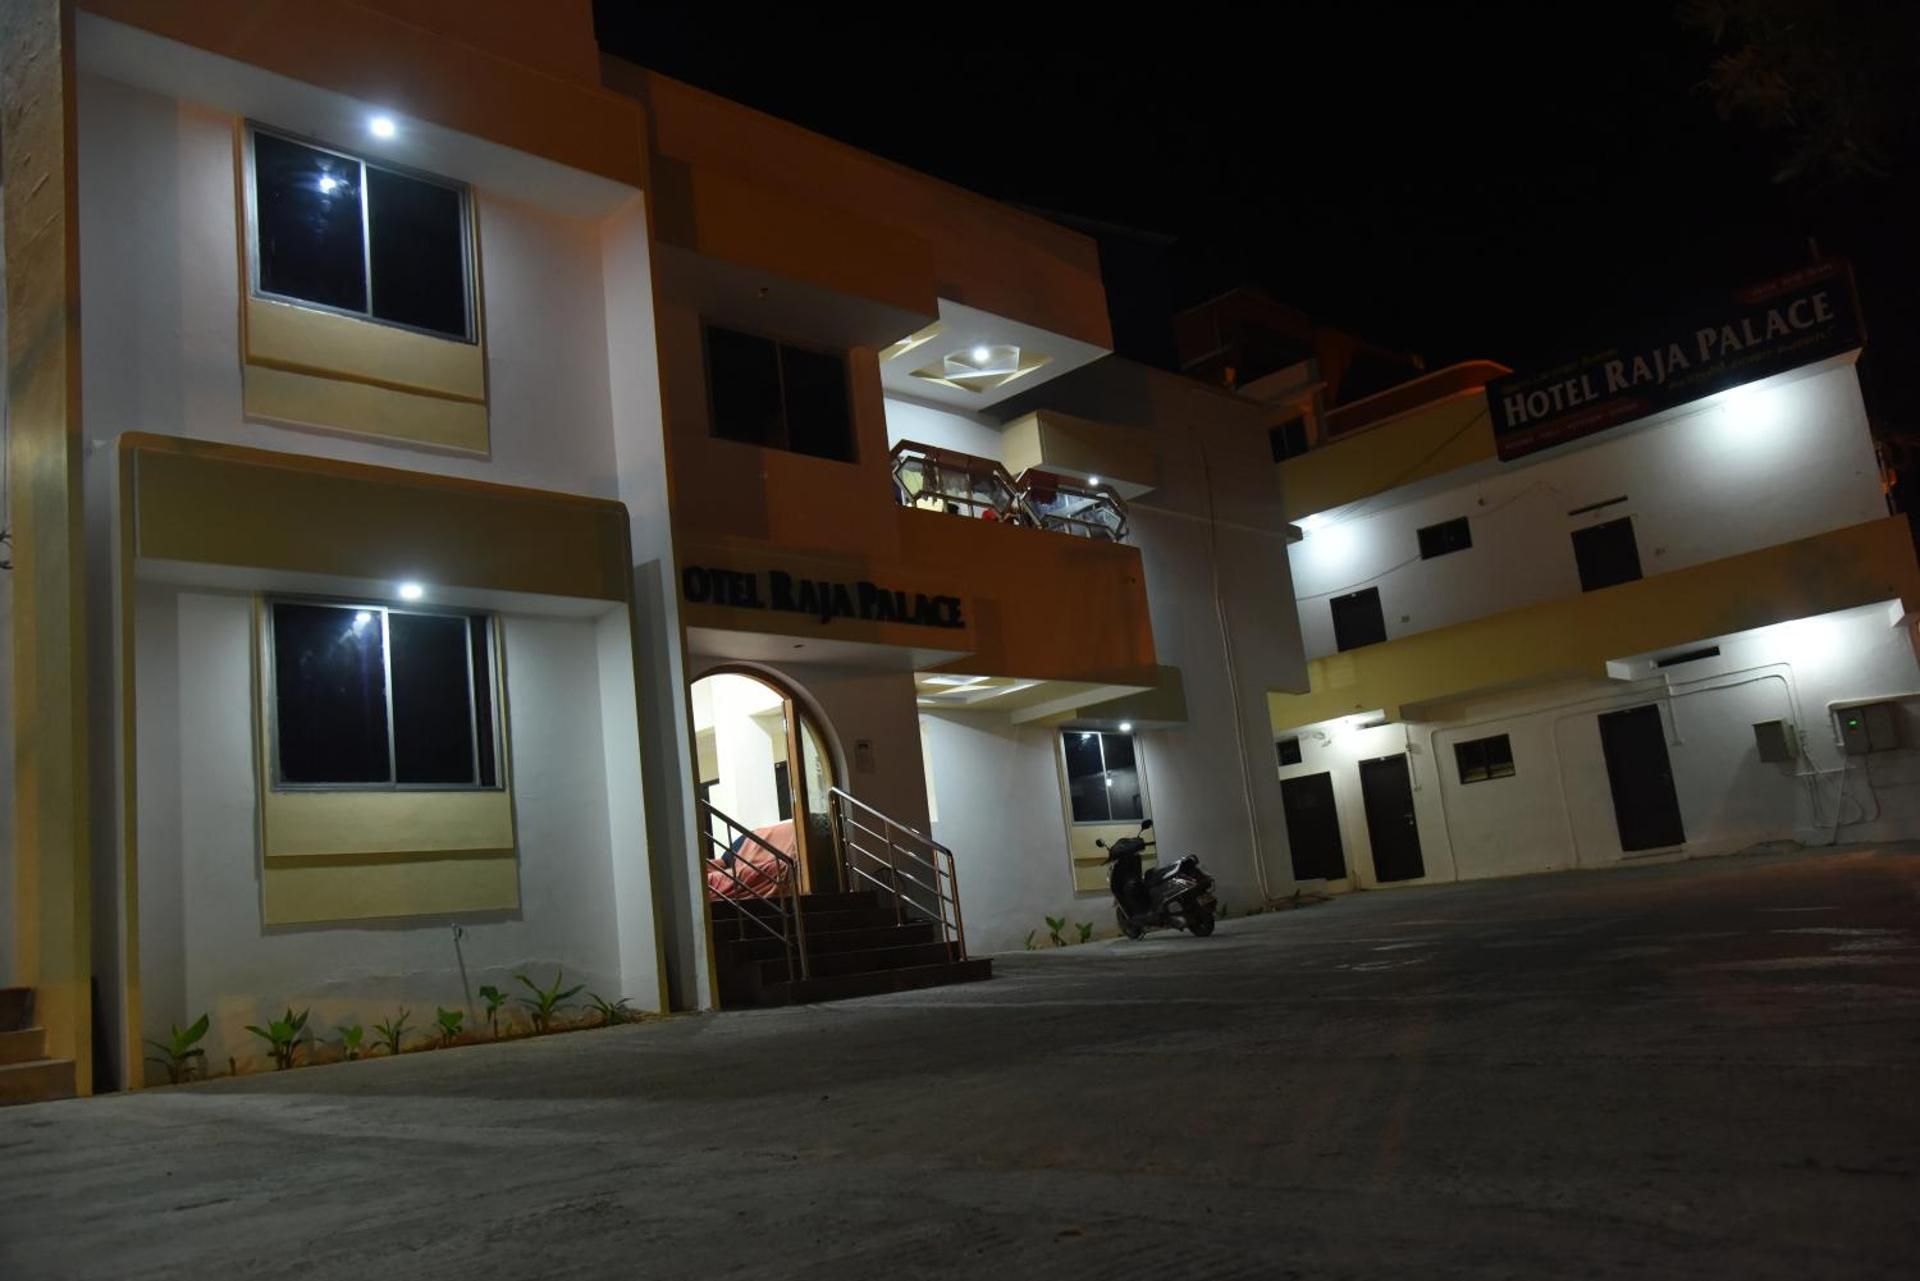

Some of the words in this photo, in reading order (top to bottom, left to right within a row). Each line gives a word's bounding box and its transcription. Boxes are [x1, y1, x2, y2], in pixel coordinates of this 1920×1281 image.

[1503, 374, 1599, 428] HOTEL
[1604, 342, 1690, 393] RAJA
[1696, 291, 1834, 360] PALACE
[684, 566, 765, 609] OTEL
[769, 570, 853, 624] RAJA
[857, 581, 965, 628] PALACE
